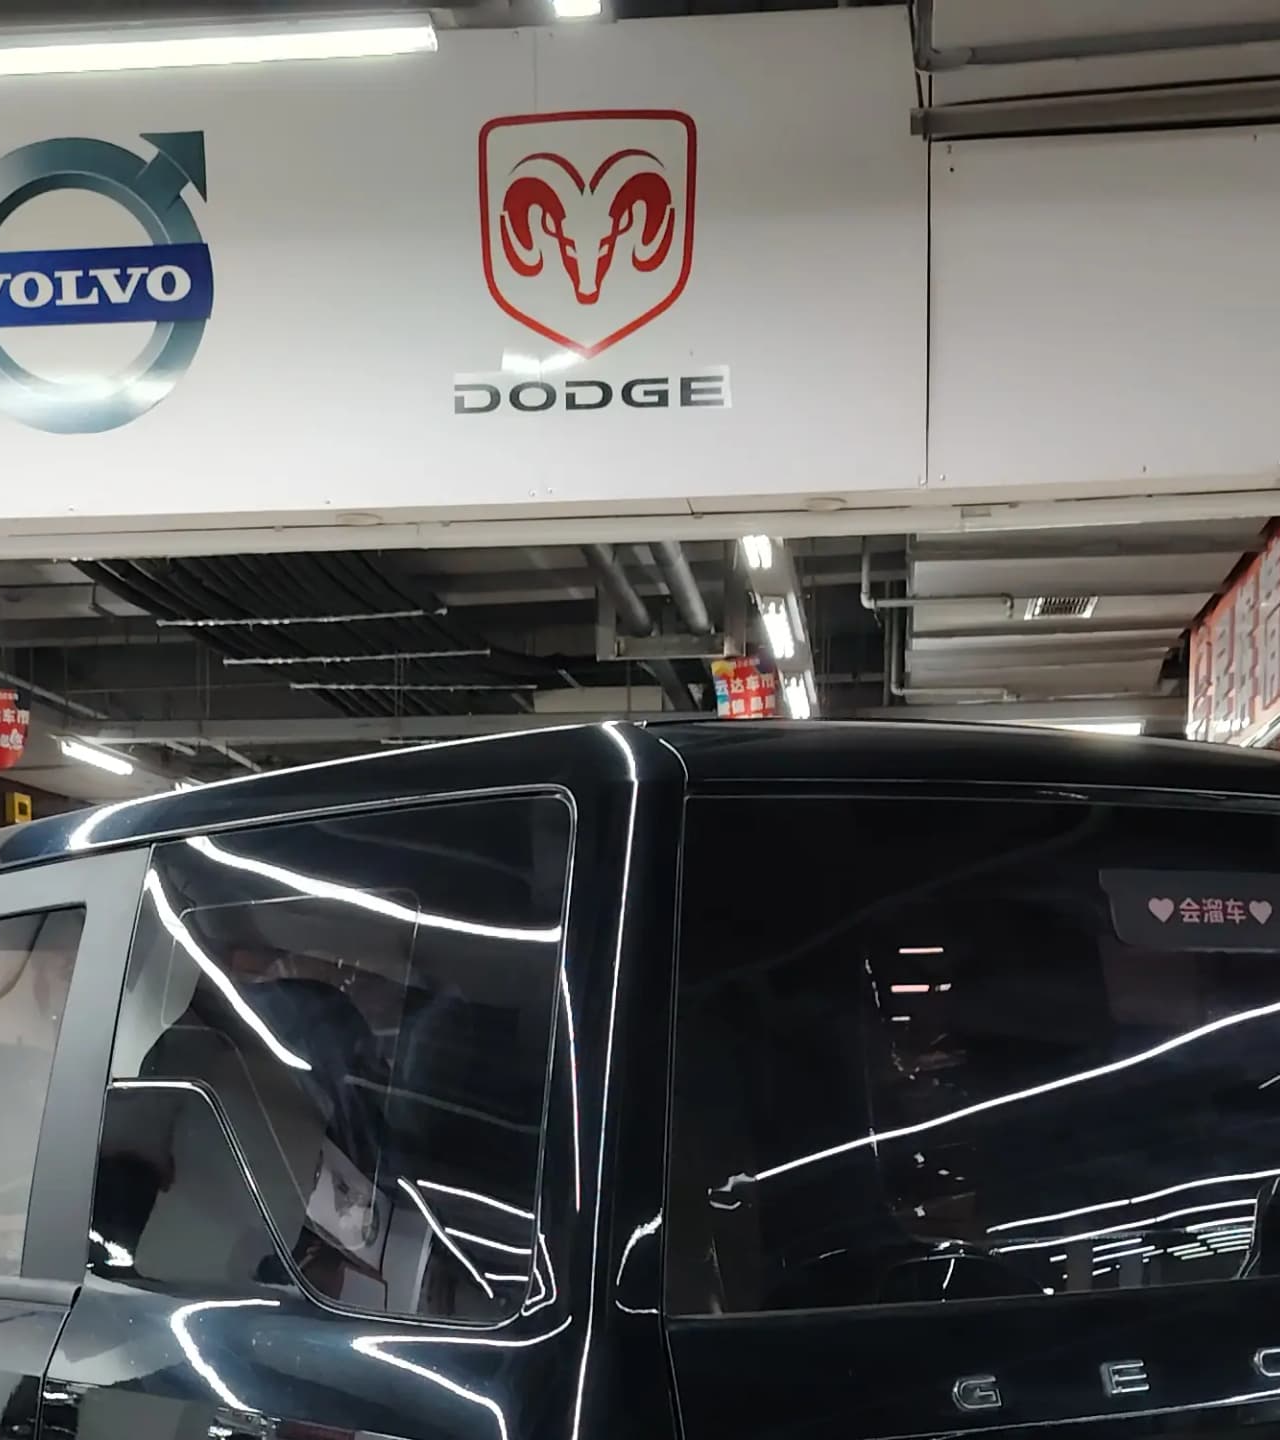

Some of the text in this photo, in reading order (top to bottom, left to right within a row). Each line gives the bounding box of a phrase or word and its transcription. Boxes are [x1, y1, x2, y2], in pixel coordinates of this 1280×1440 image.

[454, 375, 725, 415] DODGE
[1179, 897, 1247, 925] 会溜车
